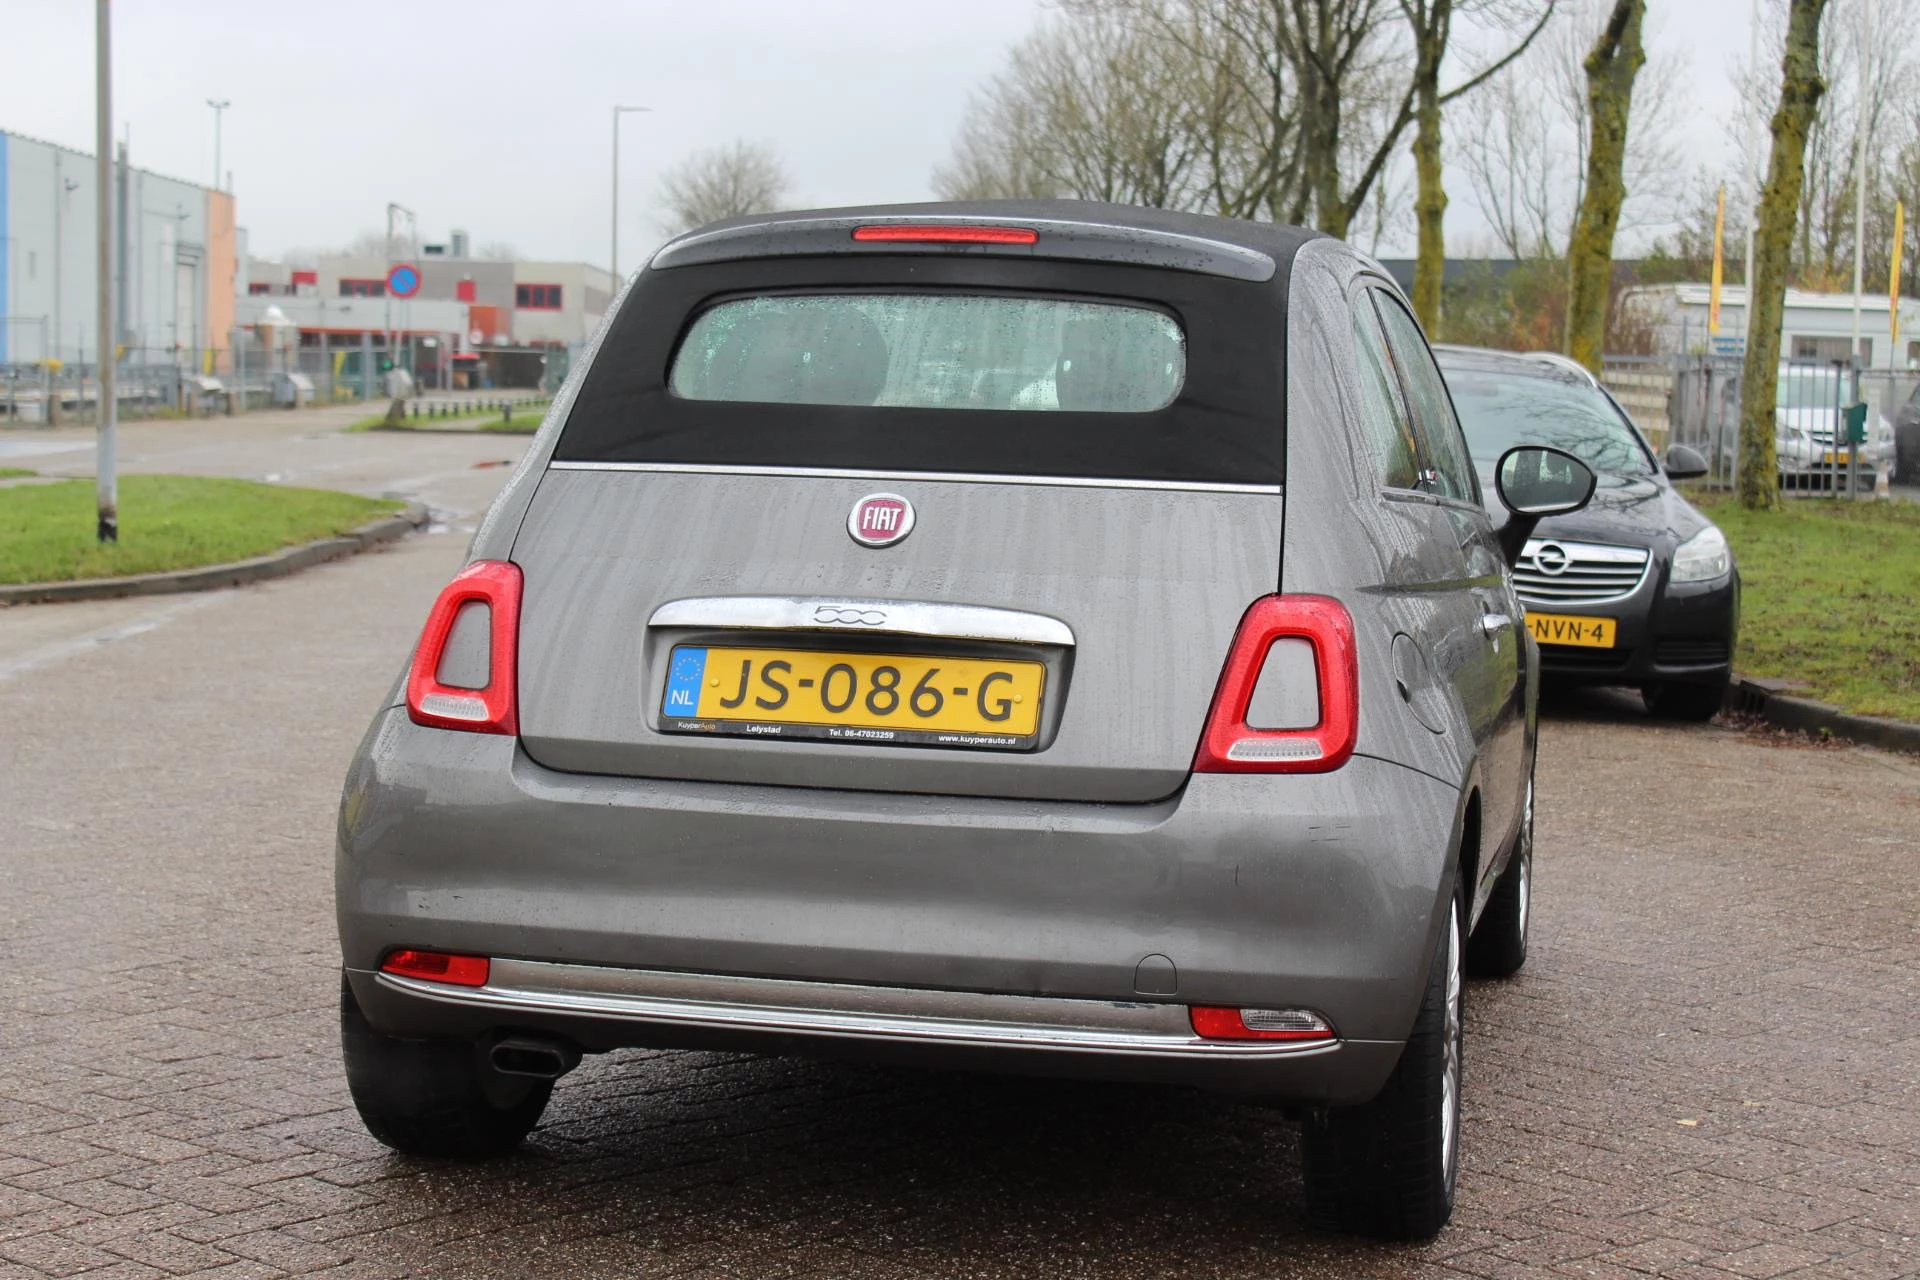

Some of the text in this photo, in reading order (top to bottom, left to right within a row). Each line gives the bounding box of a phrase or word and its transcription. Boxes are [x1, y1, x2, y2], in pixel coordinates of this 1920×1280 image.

[862, 506, 902, 531] FIAT
[813, 606, 887, 626] 500
[671, 689, 694, 706] NL
[719, 659, 1013, 722] JS-086-G
[677, 721, 716, 731] KuyperAuto
[746, 724, 781, 734] Lelystad
[829, 729, 894, 739] Tel. 06-47023259
[938, 734, 1016, 745] www.kuyperauto.nl
